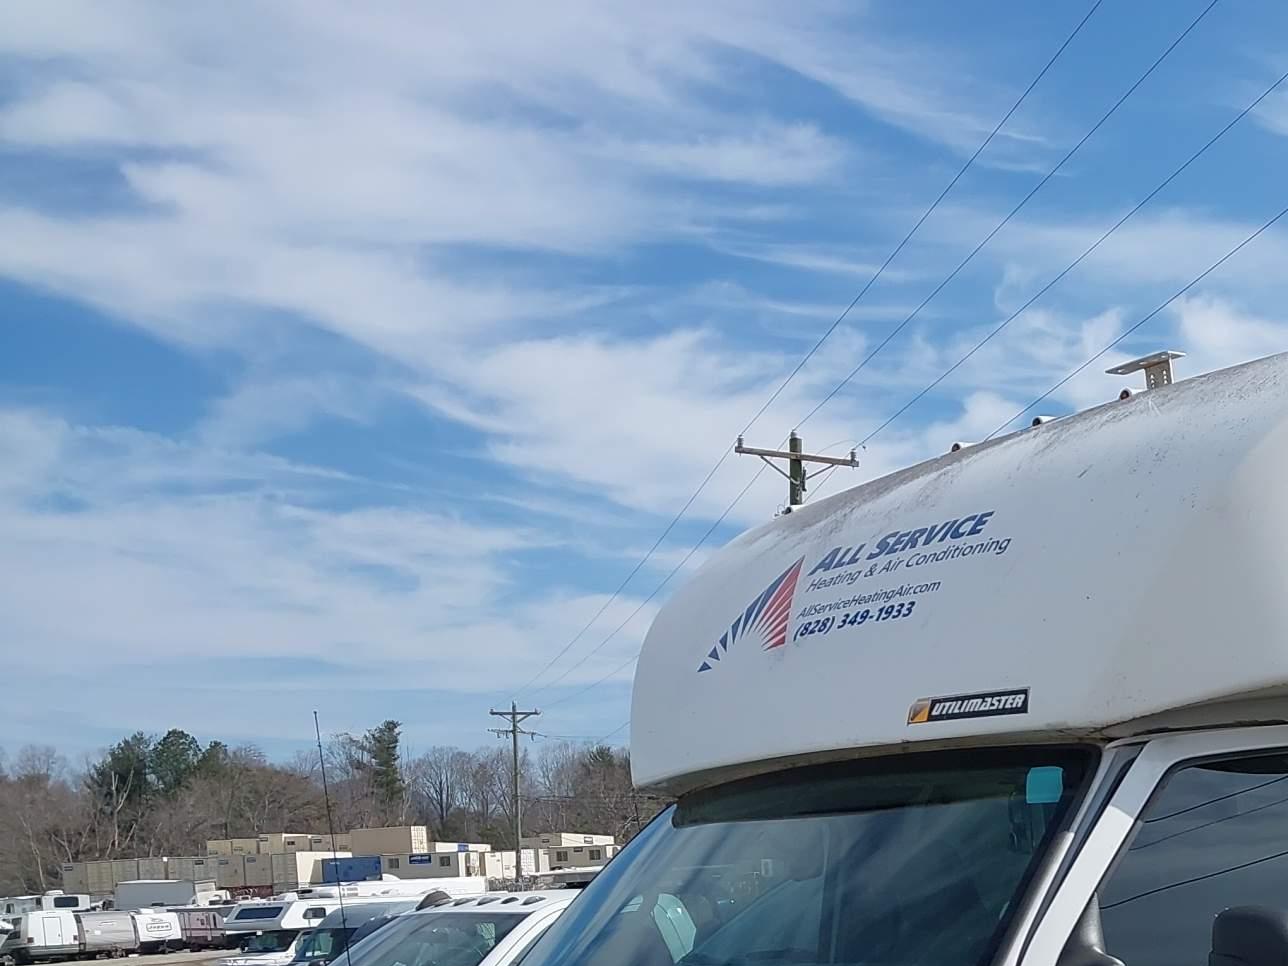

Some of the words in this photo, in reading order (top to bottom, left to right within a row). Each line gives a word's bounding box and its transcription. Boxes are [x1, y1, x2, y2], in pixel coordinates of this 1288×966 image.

[806, 568, 861, 592] Heating
[864, 564, 876, 577] &
[879, 558, 901, 574] Air
[906, 538, 1011, 567] Conditioning
[808, 544, 866, 576] ALL
[867, 511, 995, 559] SERVICE
[793, 615, 834, 641] (828)
[837, 601, 916, 629] 349-1933
[797, 580, 941, 618] AllServiceHeatingAir.com
